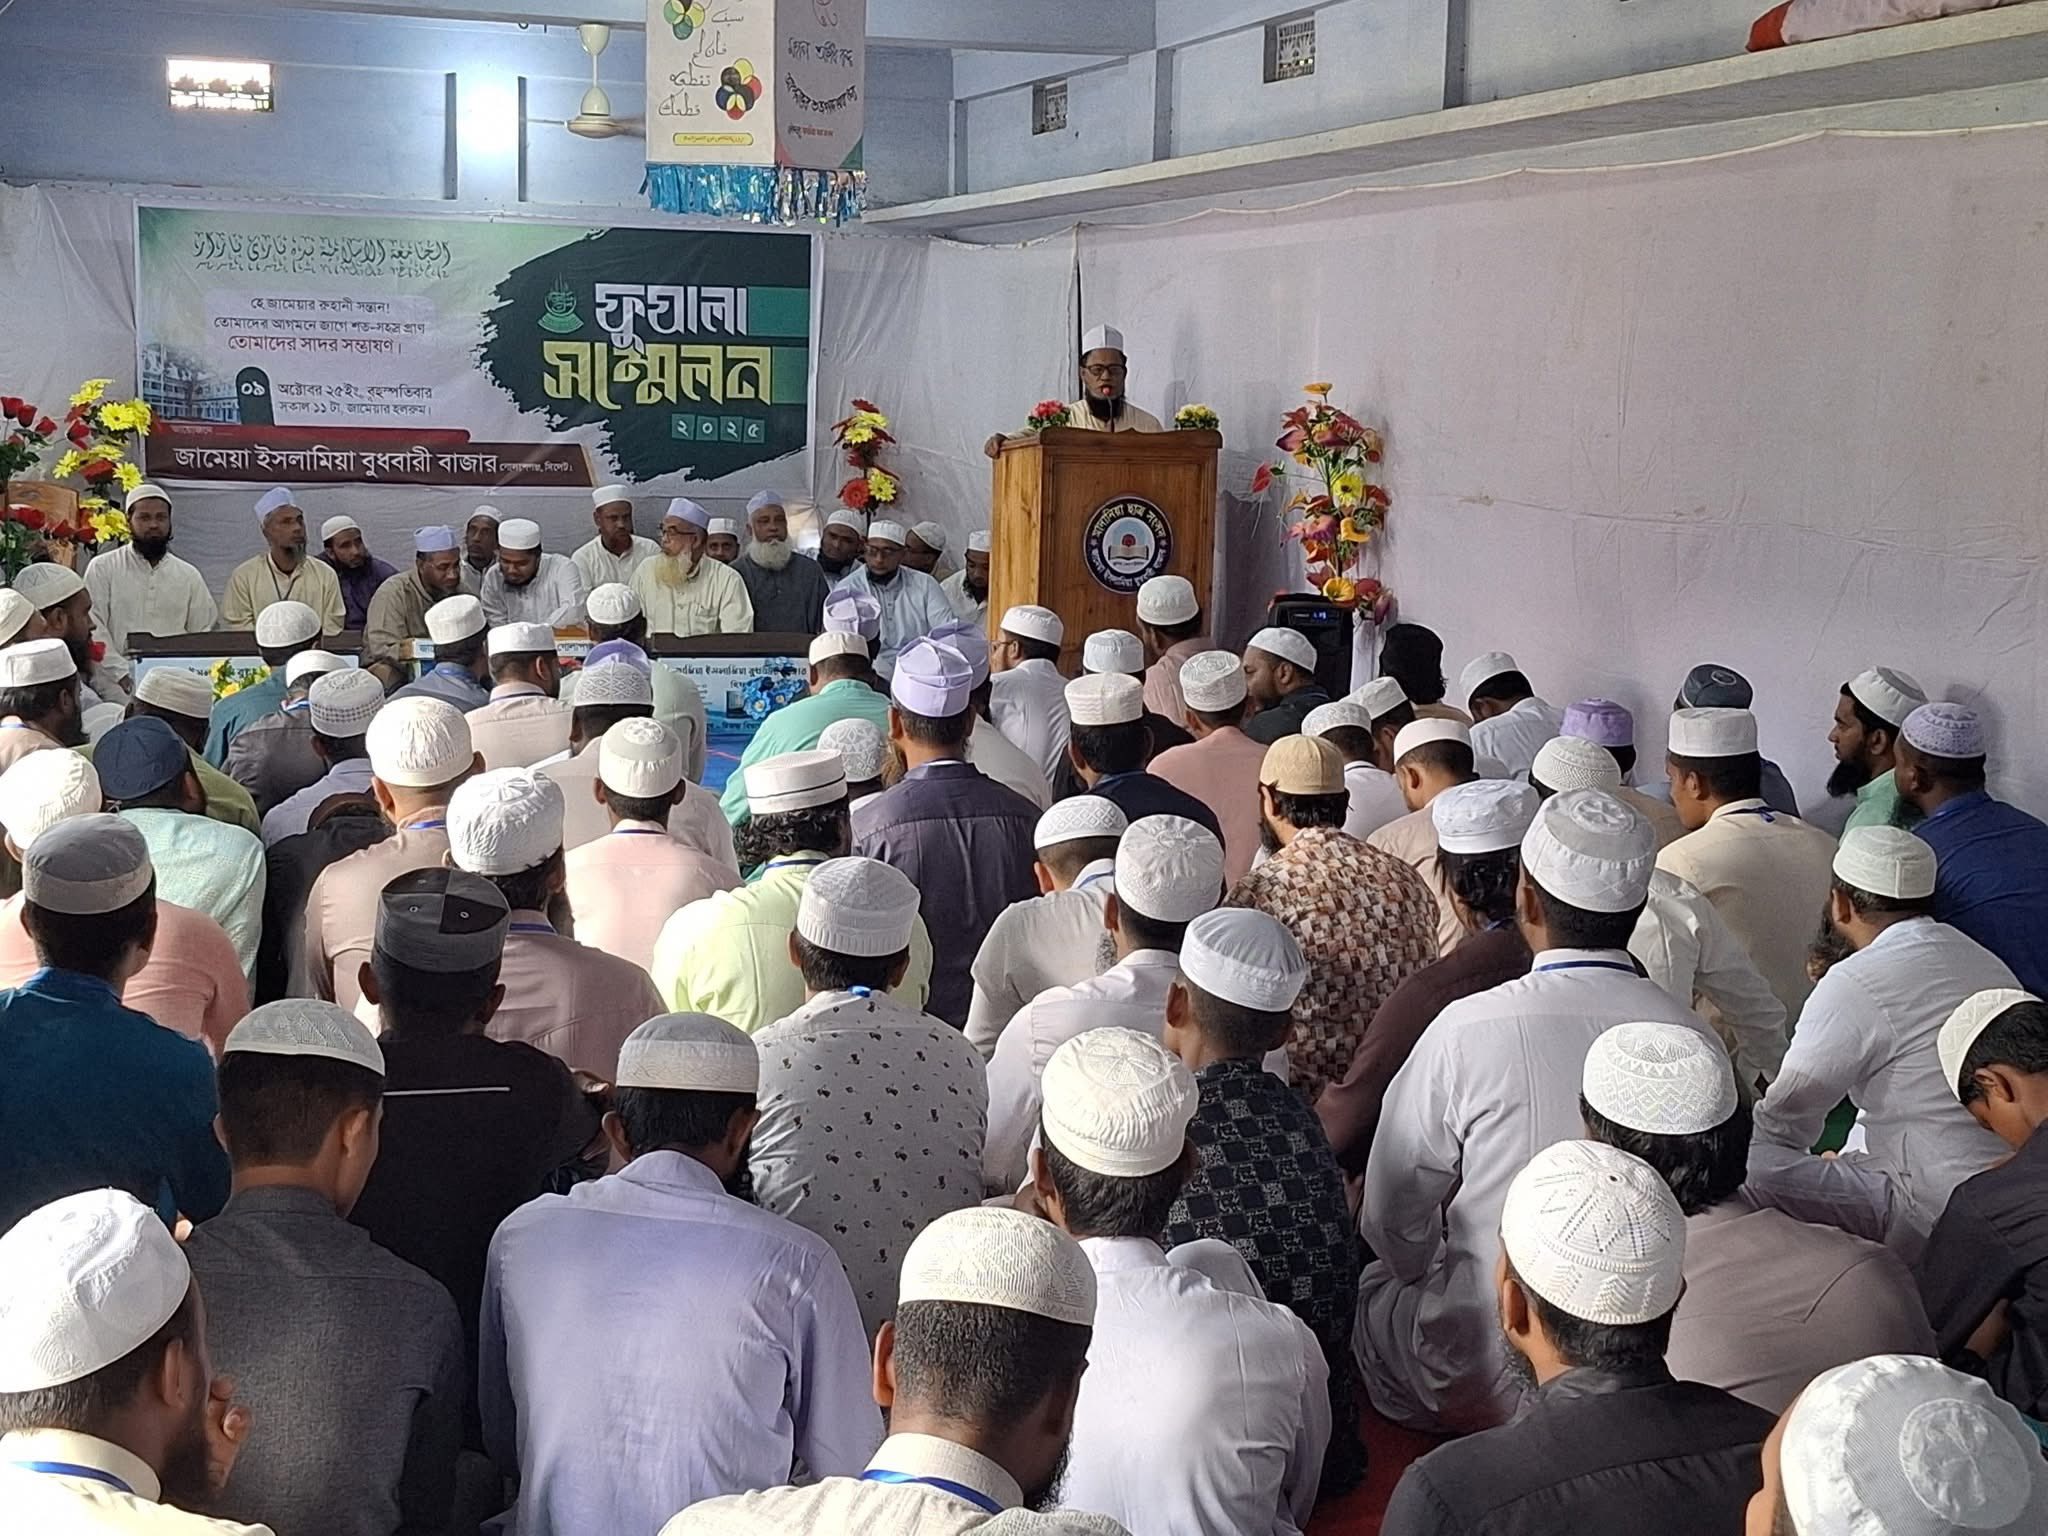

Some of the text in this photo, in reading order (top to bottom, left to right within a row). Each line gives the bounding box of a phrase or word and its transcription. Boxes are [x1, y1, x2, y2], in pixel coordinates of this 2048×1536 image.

[251, 297, 265, 310] হে
[214, 317, 268, 330] তোমাদের
[228, 336, 296, 352] তোমাদের
[300, 337, 338, 353] সাদর
[240, 380, 266, 396] ০৯
[278, 382, 322, 397] অক্টোবর
[279, 401, 310, 413] সকাল
[313, 402, 327, 413] ১১
[173, 447, 250, 469] জামেয়া
[253, 444, 356, 472] ইসলামিয়া
[359, 446, 432, 478] বুধবারী
[436, 453, 499, 473] বাজার
